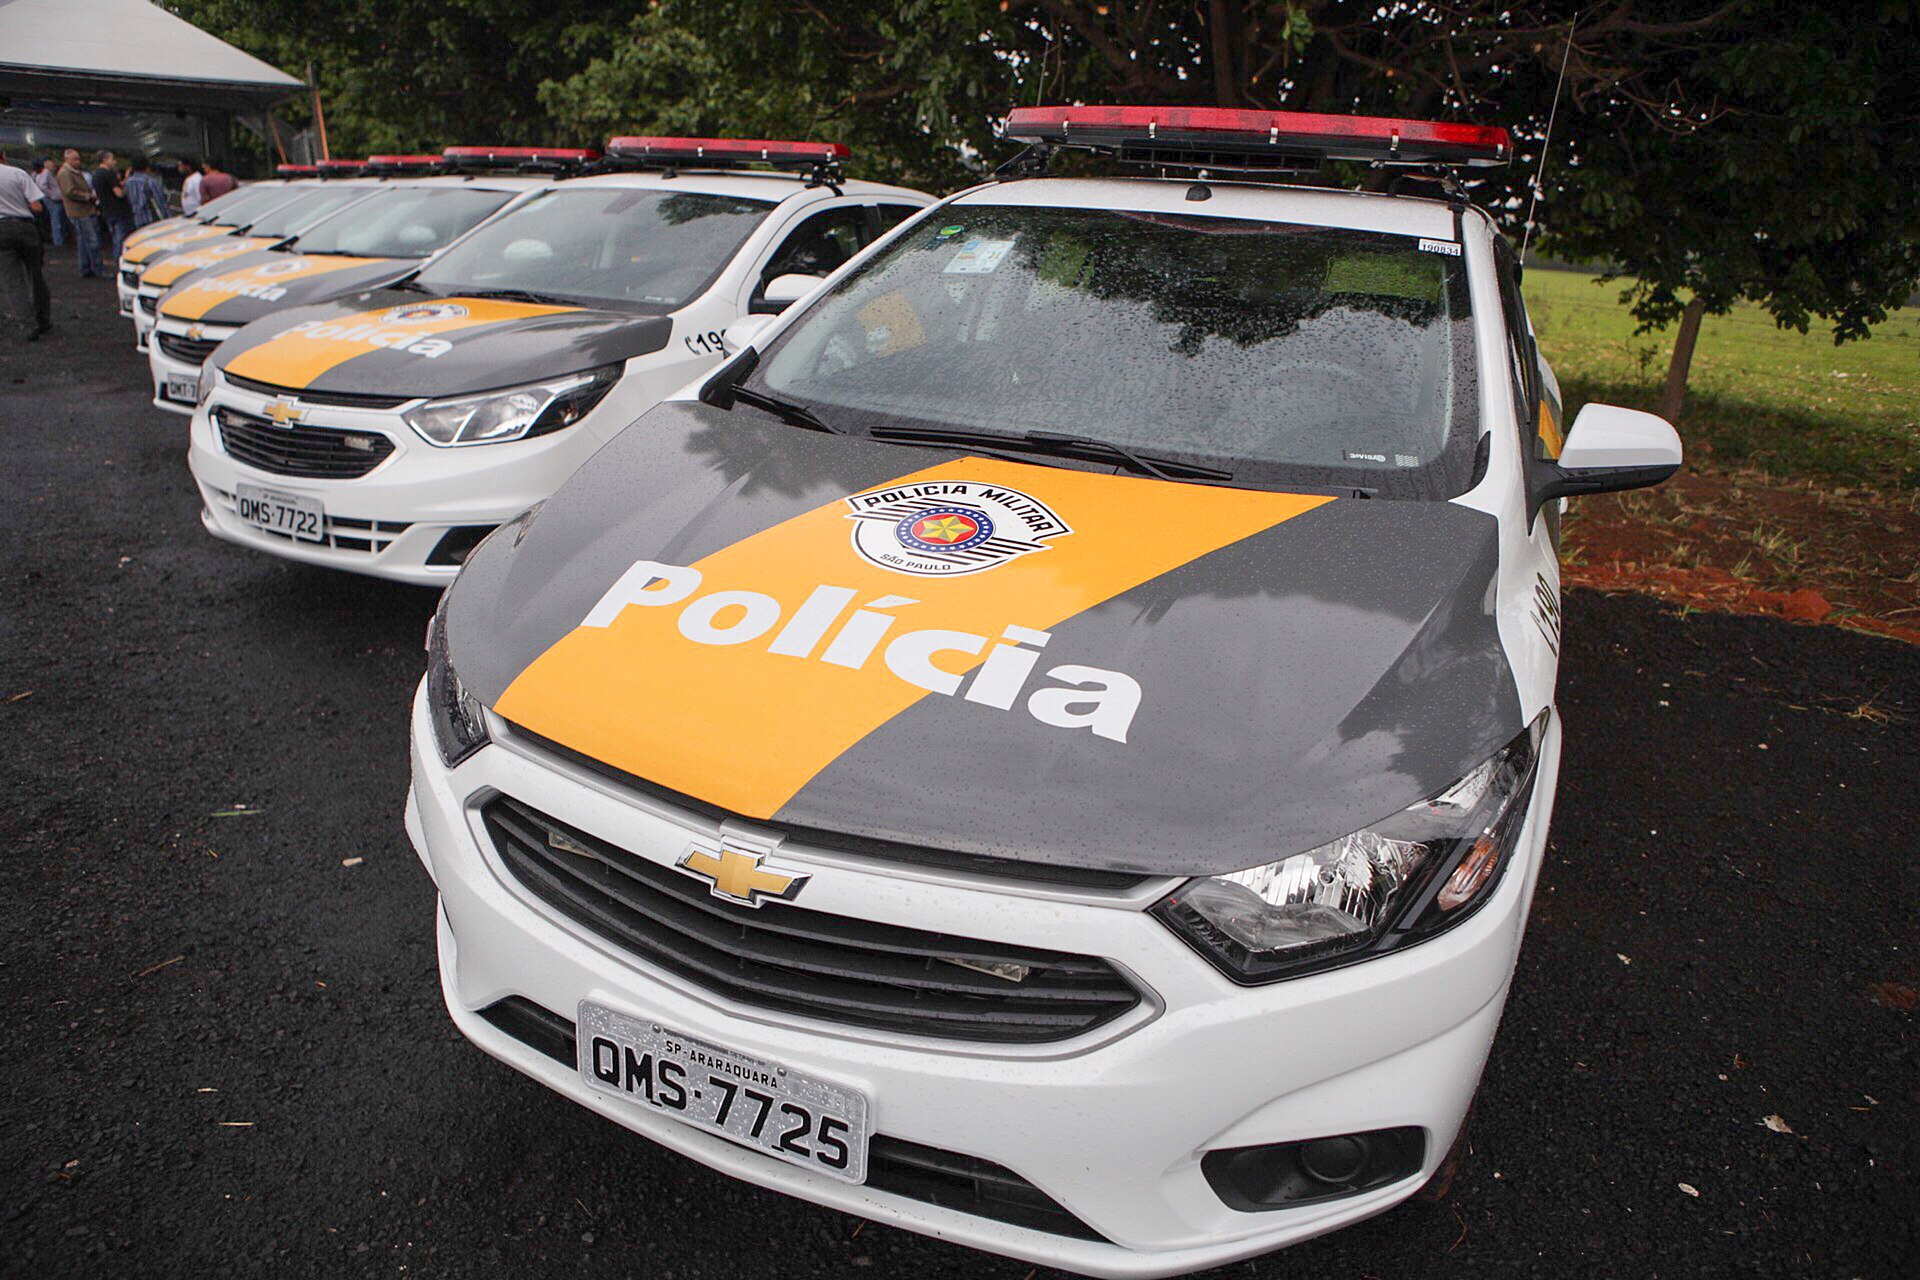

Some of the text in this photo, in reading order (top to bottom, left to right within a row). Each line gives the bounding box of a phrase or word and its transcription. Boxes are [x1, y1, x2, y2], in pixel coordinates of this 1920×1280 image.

[696, 329, 726, 353] 19
[864, 485, 1054, 533] POLICIA MILITAR
[879, 553, 951, 571] SÃO PAULO
[579, 559, 1142, 744] Polícia
